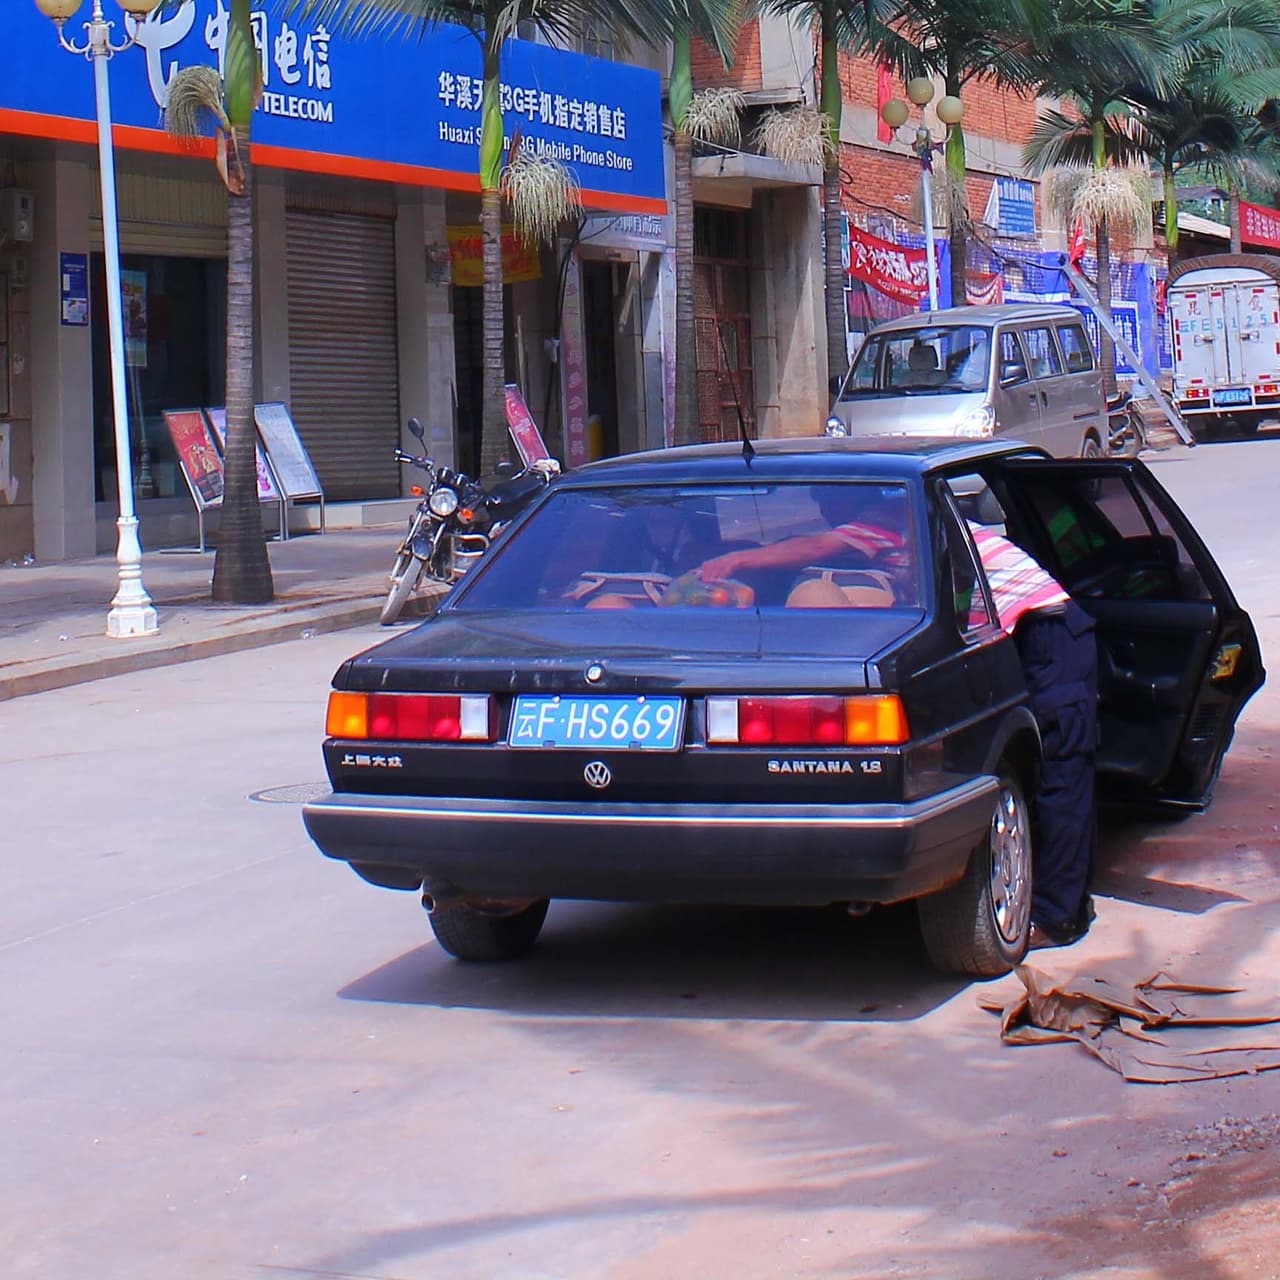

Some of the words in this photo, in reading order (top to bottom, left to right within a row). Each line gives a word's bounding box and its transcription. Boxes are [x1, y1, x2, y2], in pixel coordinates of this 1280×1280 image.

[262, 92, 333, 122] TELECOM
[439, 122, 474, 145] Huaxi
[536, 138, 571, 161] Mobile
[574, 145, 605, 166] Phone
[606, 150, 632, 170] Store
[767, 760, 854, 774] SANTANA
